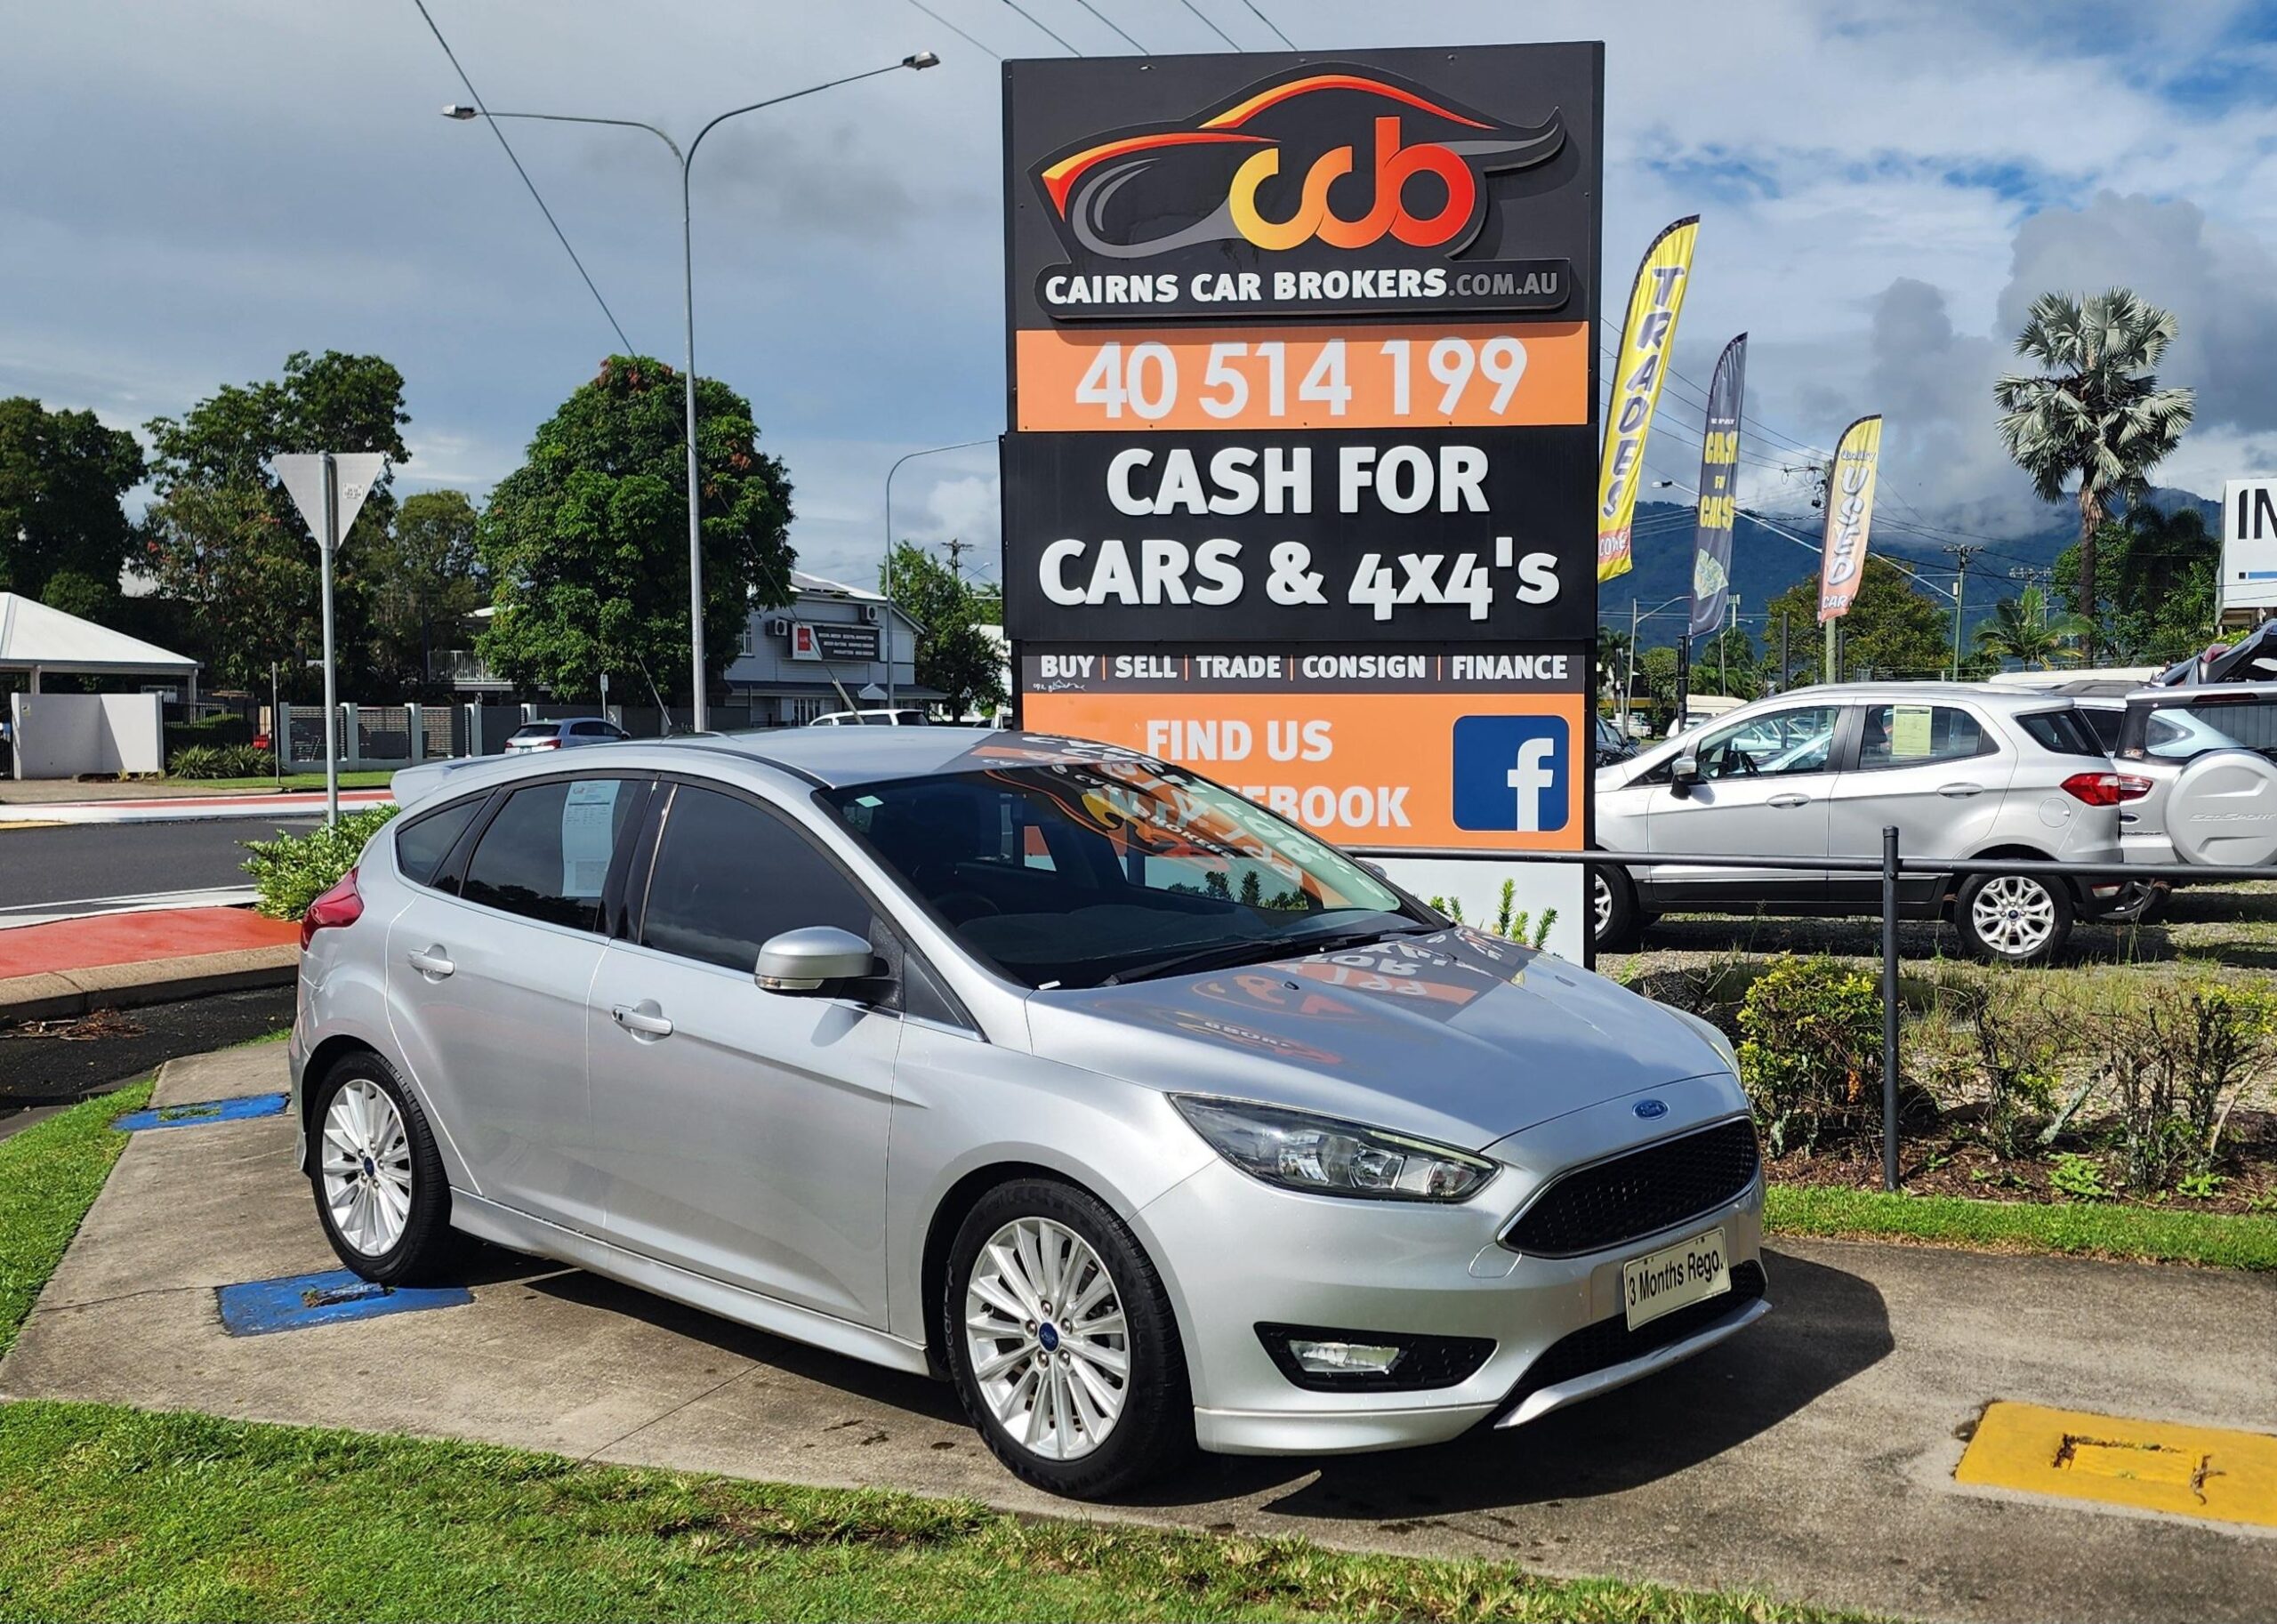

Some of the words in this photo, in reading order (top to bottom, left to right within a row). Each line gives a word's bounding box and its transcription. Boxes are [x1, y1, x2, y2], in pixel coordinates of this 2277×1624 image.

[1045, 273, 1179, 304] CAIRNS
[1191, 270, 1262, 301] CAR
[1075, 341, 1179, 419] 40
[1198, 338, 1352, 417] 514
[1380, 336, 1528, 416] 199
[1106, 446, 1313, 517] CASH
[1339, 445, 1491, 514] FOR
[1828, 465, 1870, 586] USED
[1039, 538, 1245, 607] CARS
[1266, 541, 1329, 606] &
[1041, 655, 1096, 679] BUY
[1114, 655, 1178, 679] SELL
[1196, 655, 1282, 679] TRADE
[1302, 655, 1427, 679] CONSIGN
[1452, 655, 1569, 680] FINANCE
[1147, 720, 1252, 762] FIND
[1267, 720, 1333, 762] US
[1629, 1276, 1637, 1306] 3
[1640, 1259, 1684, 1301] Months
[1687, 1250, 1724, 1283] Rego.
